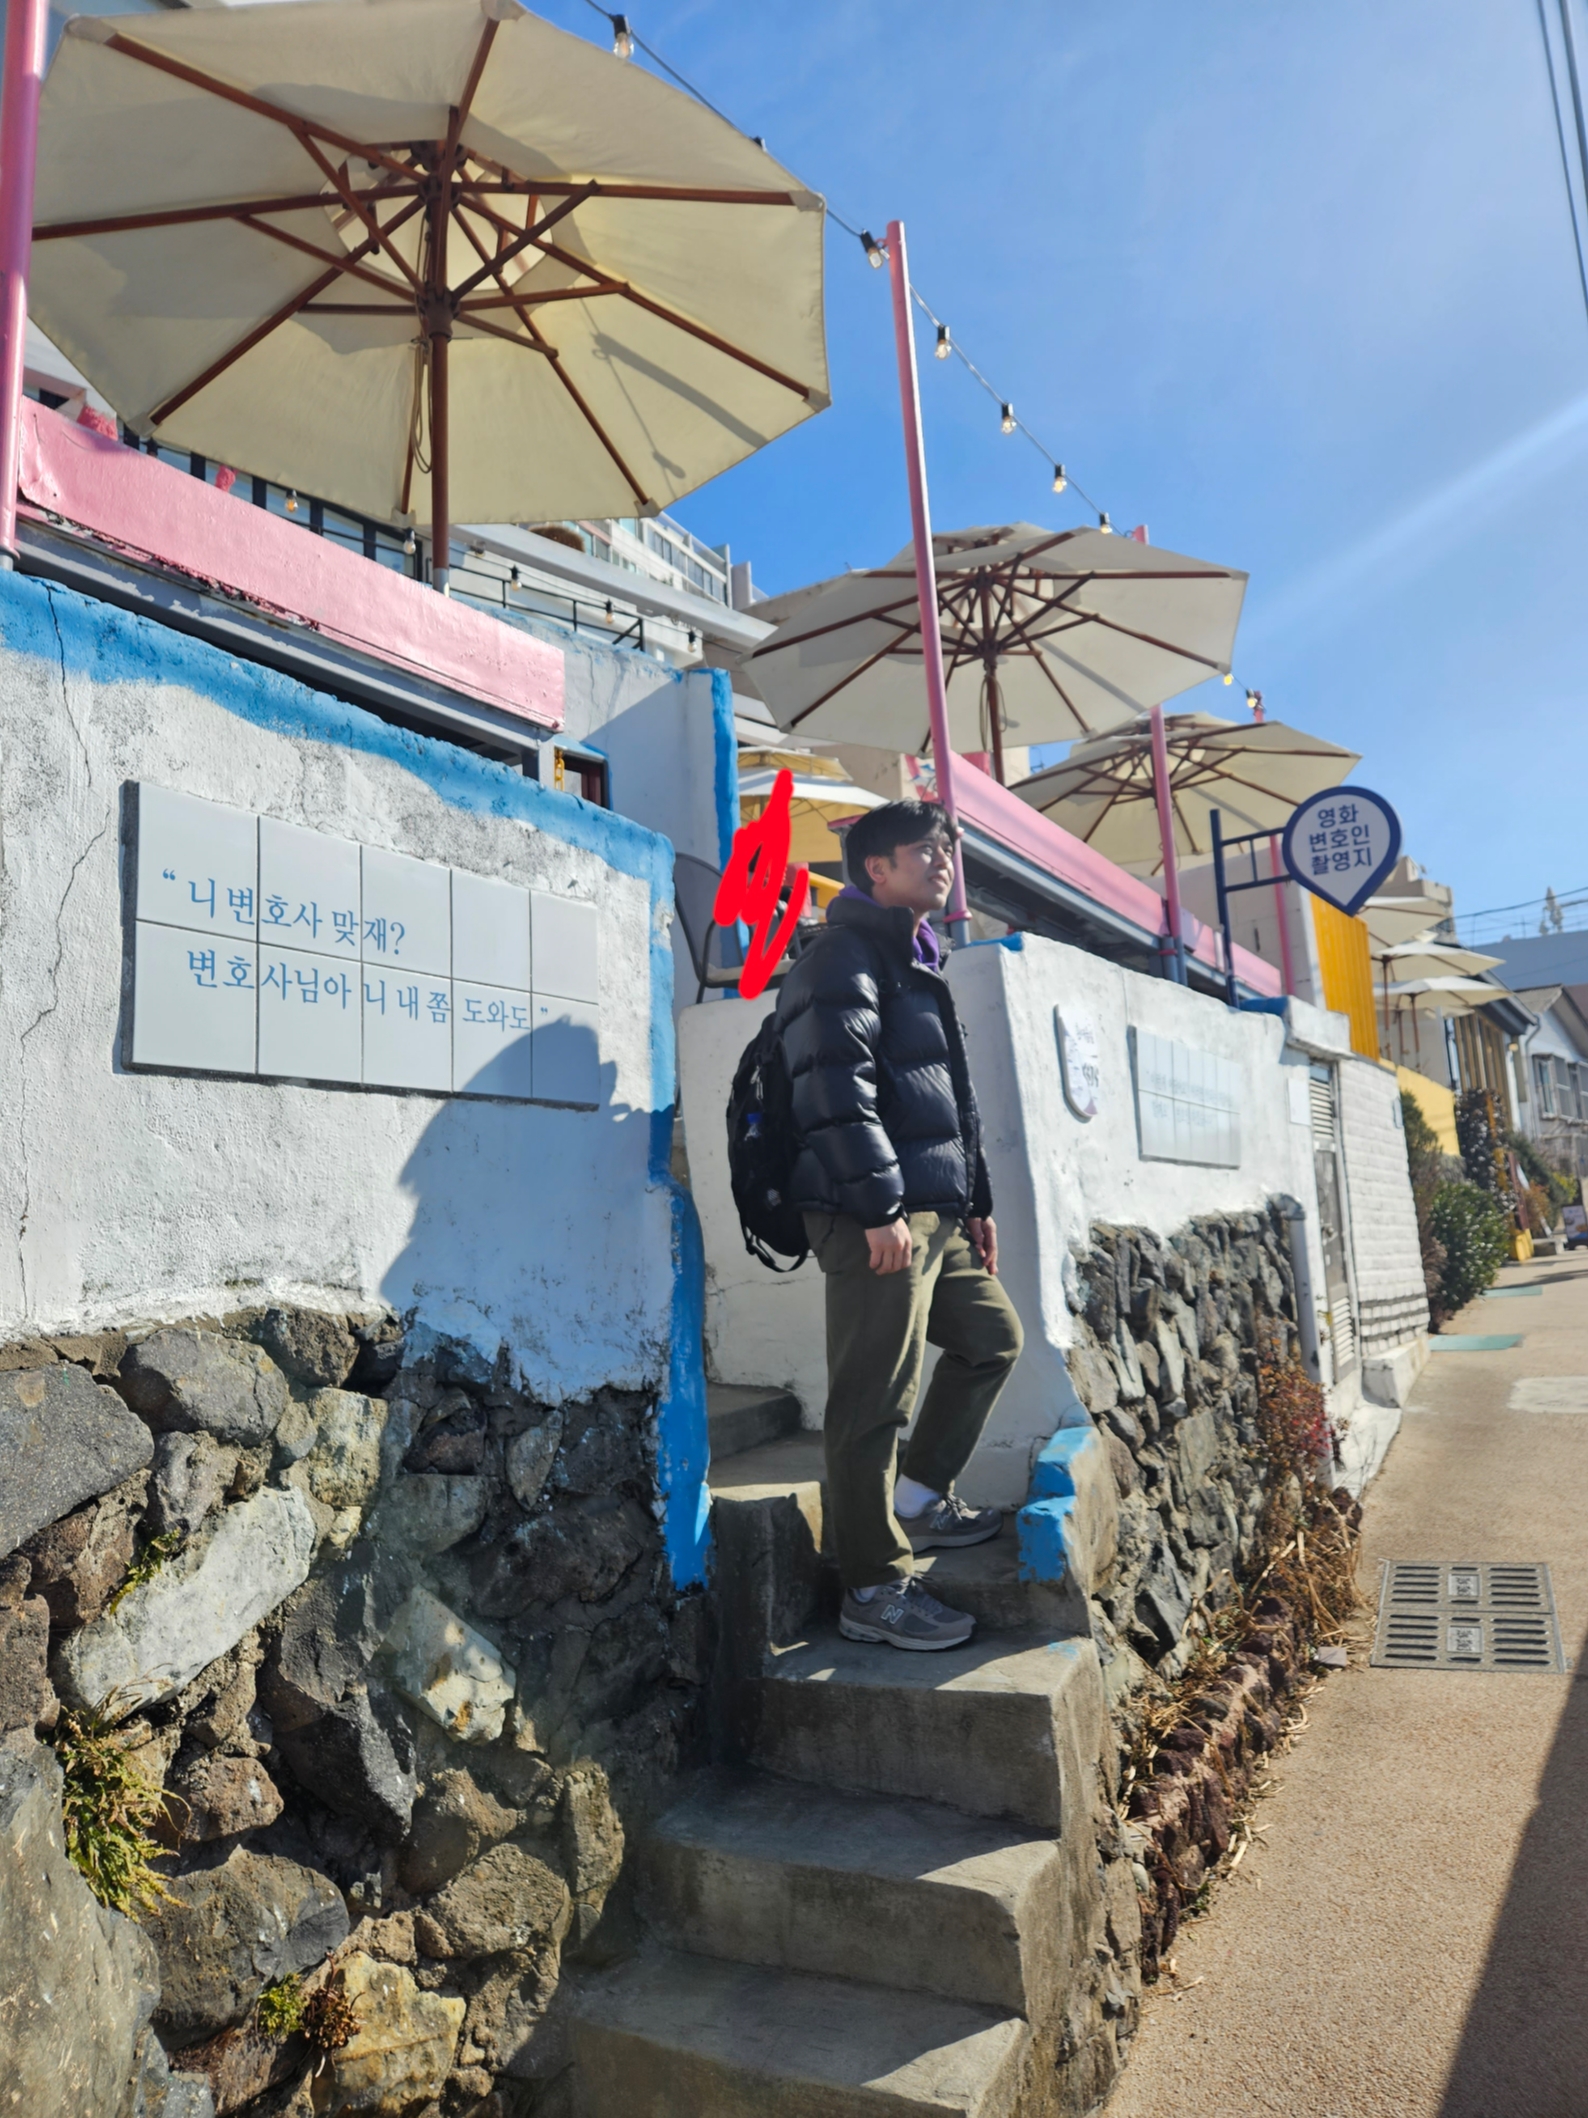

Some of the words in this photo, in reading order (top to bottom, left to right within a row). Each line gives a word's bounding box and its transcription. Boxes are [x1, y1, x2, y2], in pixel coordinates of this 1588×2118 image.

[1317, 803, 1359, 829] 영화
[1309, 824, 1371, 853] 변호인
[1311, 846, 1372, 876] 촬영지
[226, 887, 323, 939] 변호사
[331, 910, 406, 955] 맞재?
[187, 949, 352, 1010] 변호사님아
[363, 980, 386, 1016] 니
[396, 986, 419, 1021] 내
[881, 1604, 905, 1625] N
